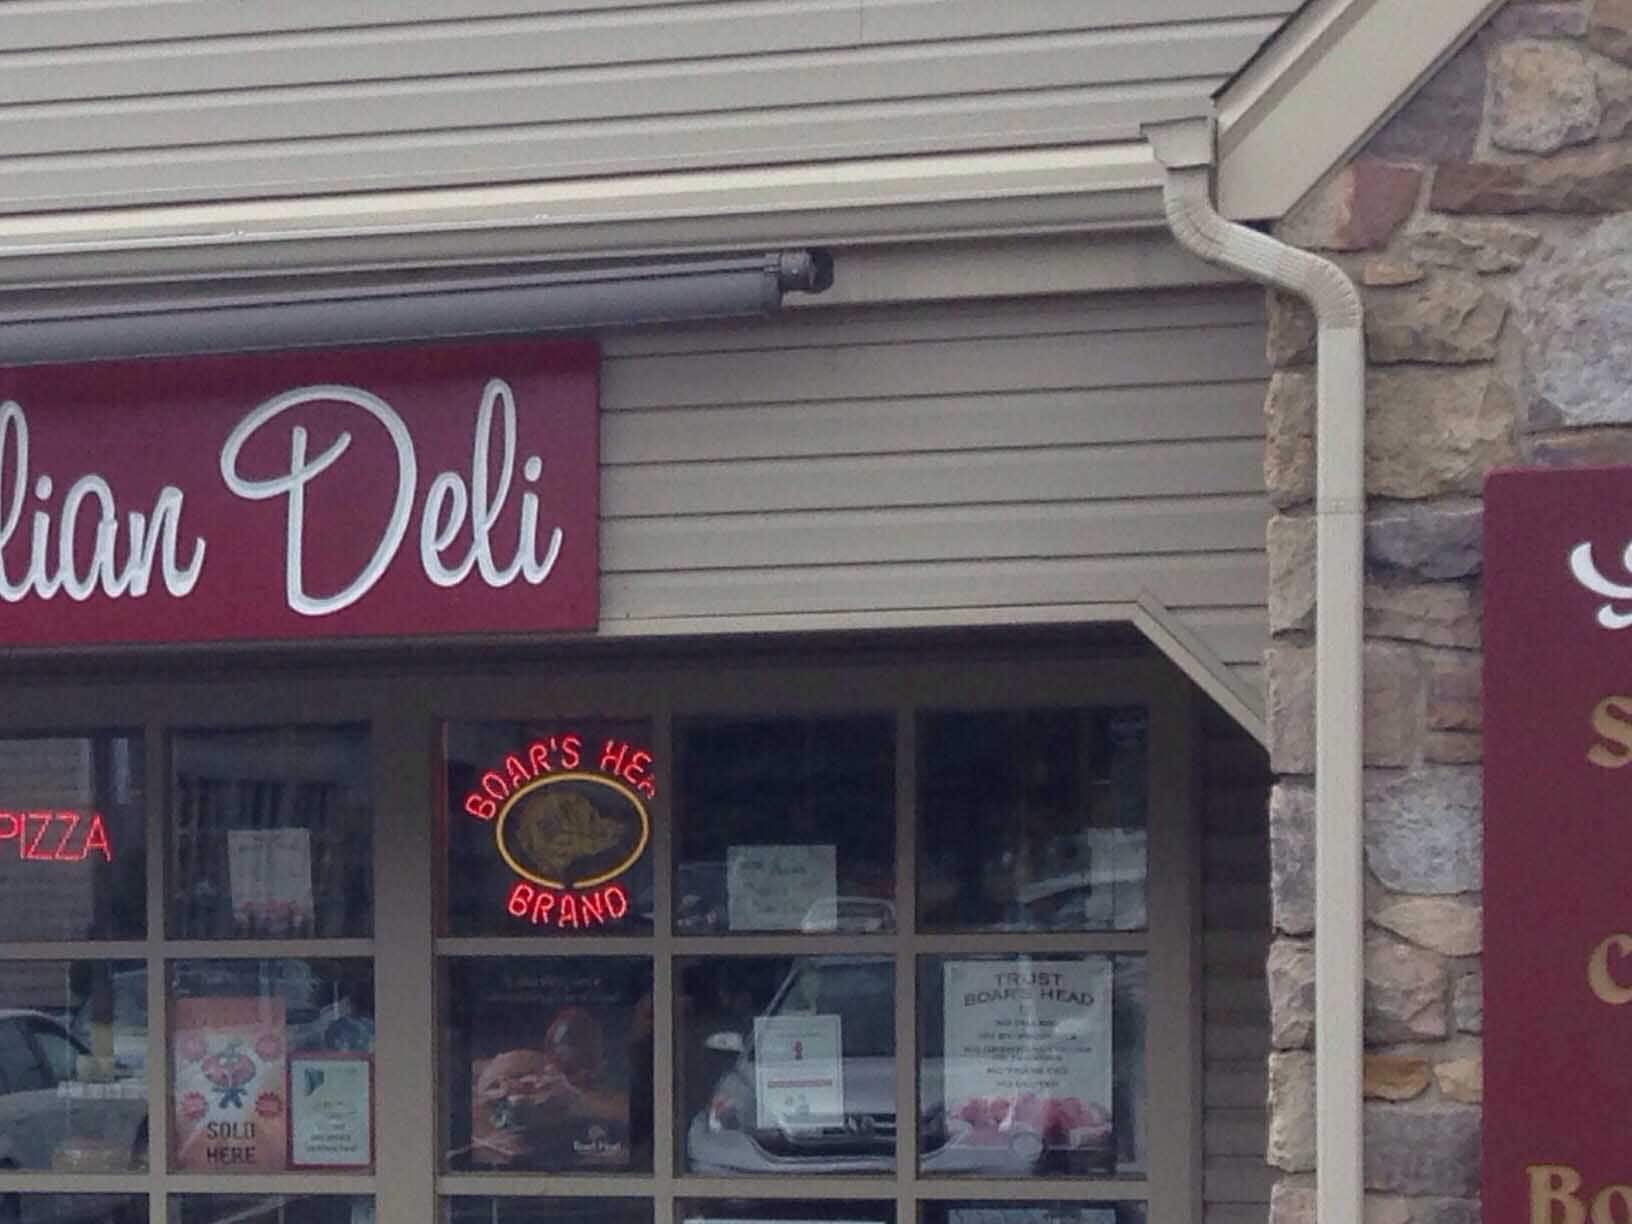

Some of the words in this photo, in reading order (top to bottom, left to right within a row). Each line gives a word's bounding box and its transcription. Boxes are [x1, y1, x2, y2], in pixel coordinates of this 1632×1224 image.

[220, 378, 564, 615] Deli
[464, 735, 583, 821] BOAR'S
[508, 883, 628, 929] BRAND
[206, 1120, 256, 1141] SOLD
[206, 1146, 257, 1165] HERE
